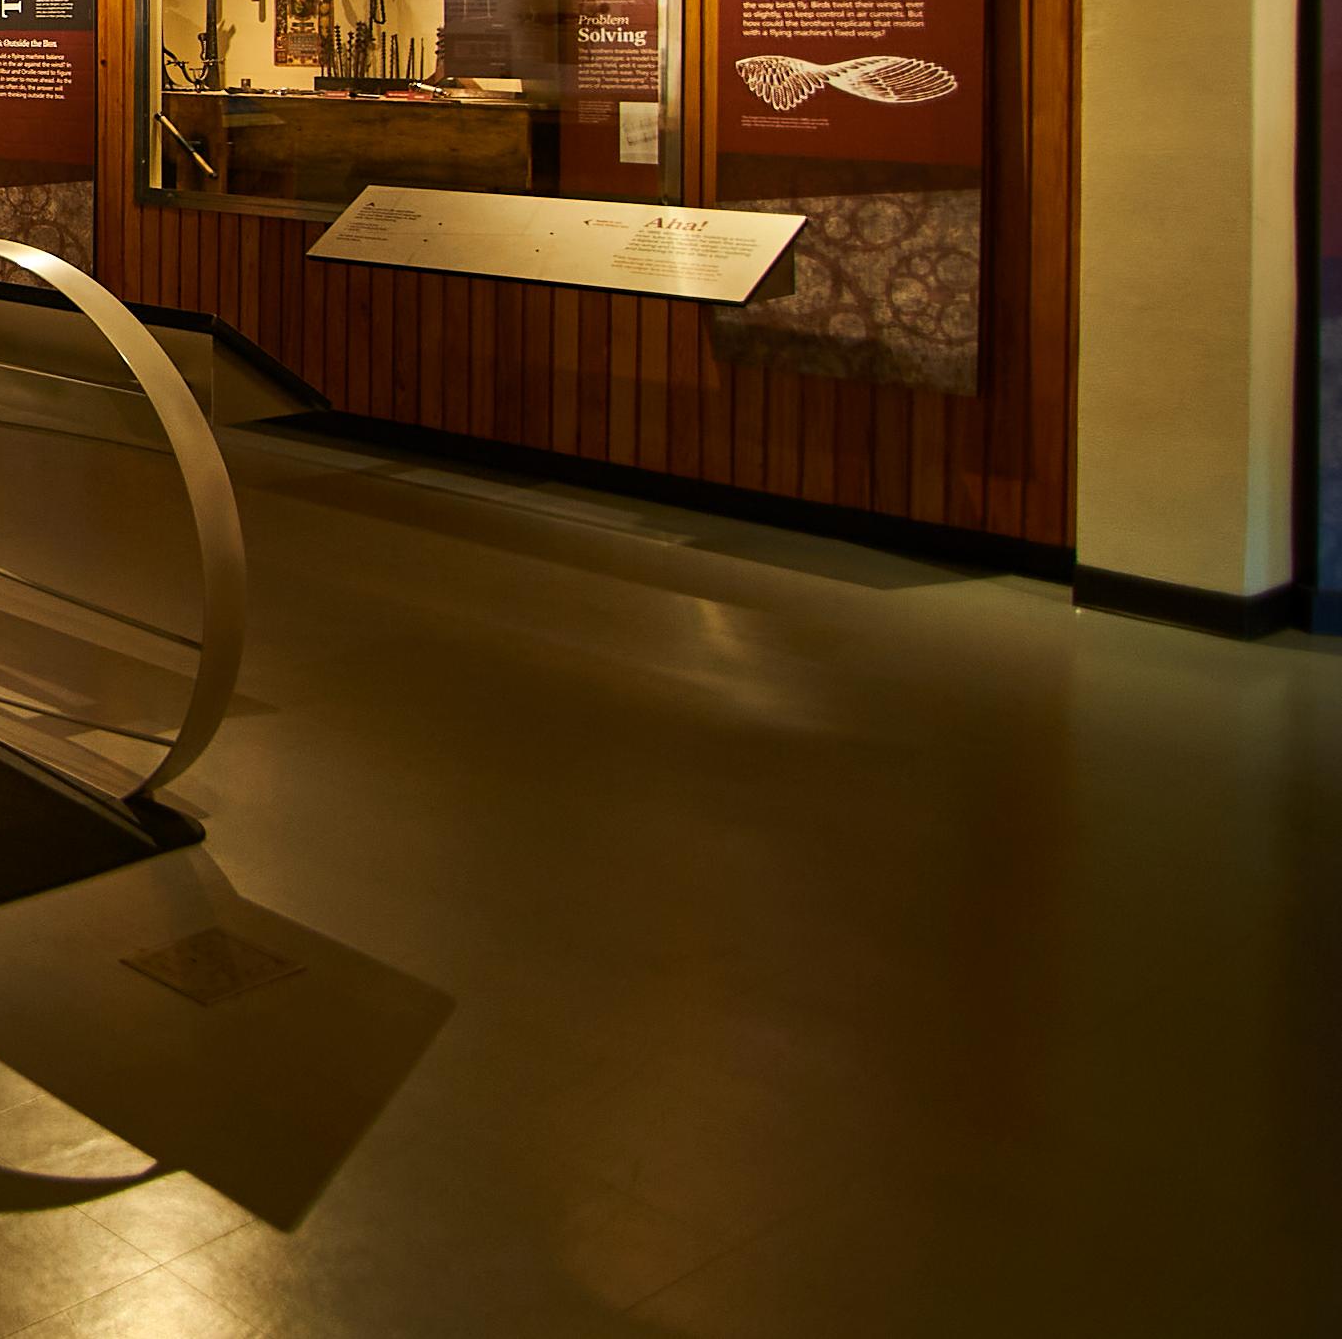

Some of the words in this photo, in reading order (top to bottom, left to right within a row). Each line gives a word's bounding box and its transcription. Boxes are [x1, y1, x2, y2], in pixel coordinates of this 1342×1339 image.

[578, 14, 630, 25] Problem
[2, 38, 30, 47] Outside
[30, 39, 42, 47] the
[42, 39, 57, 47] Box
[577, 27, 647, 47] Solving
[645, 217, 708, 232] Aha!
